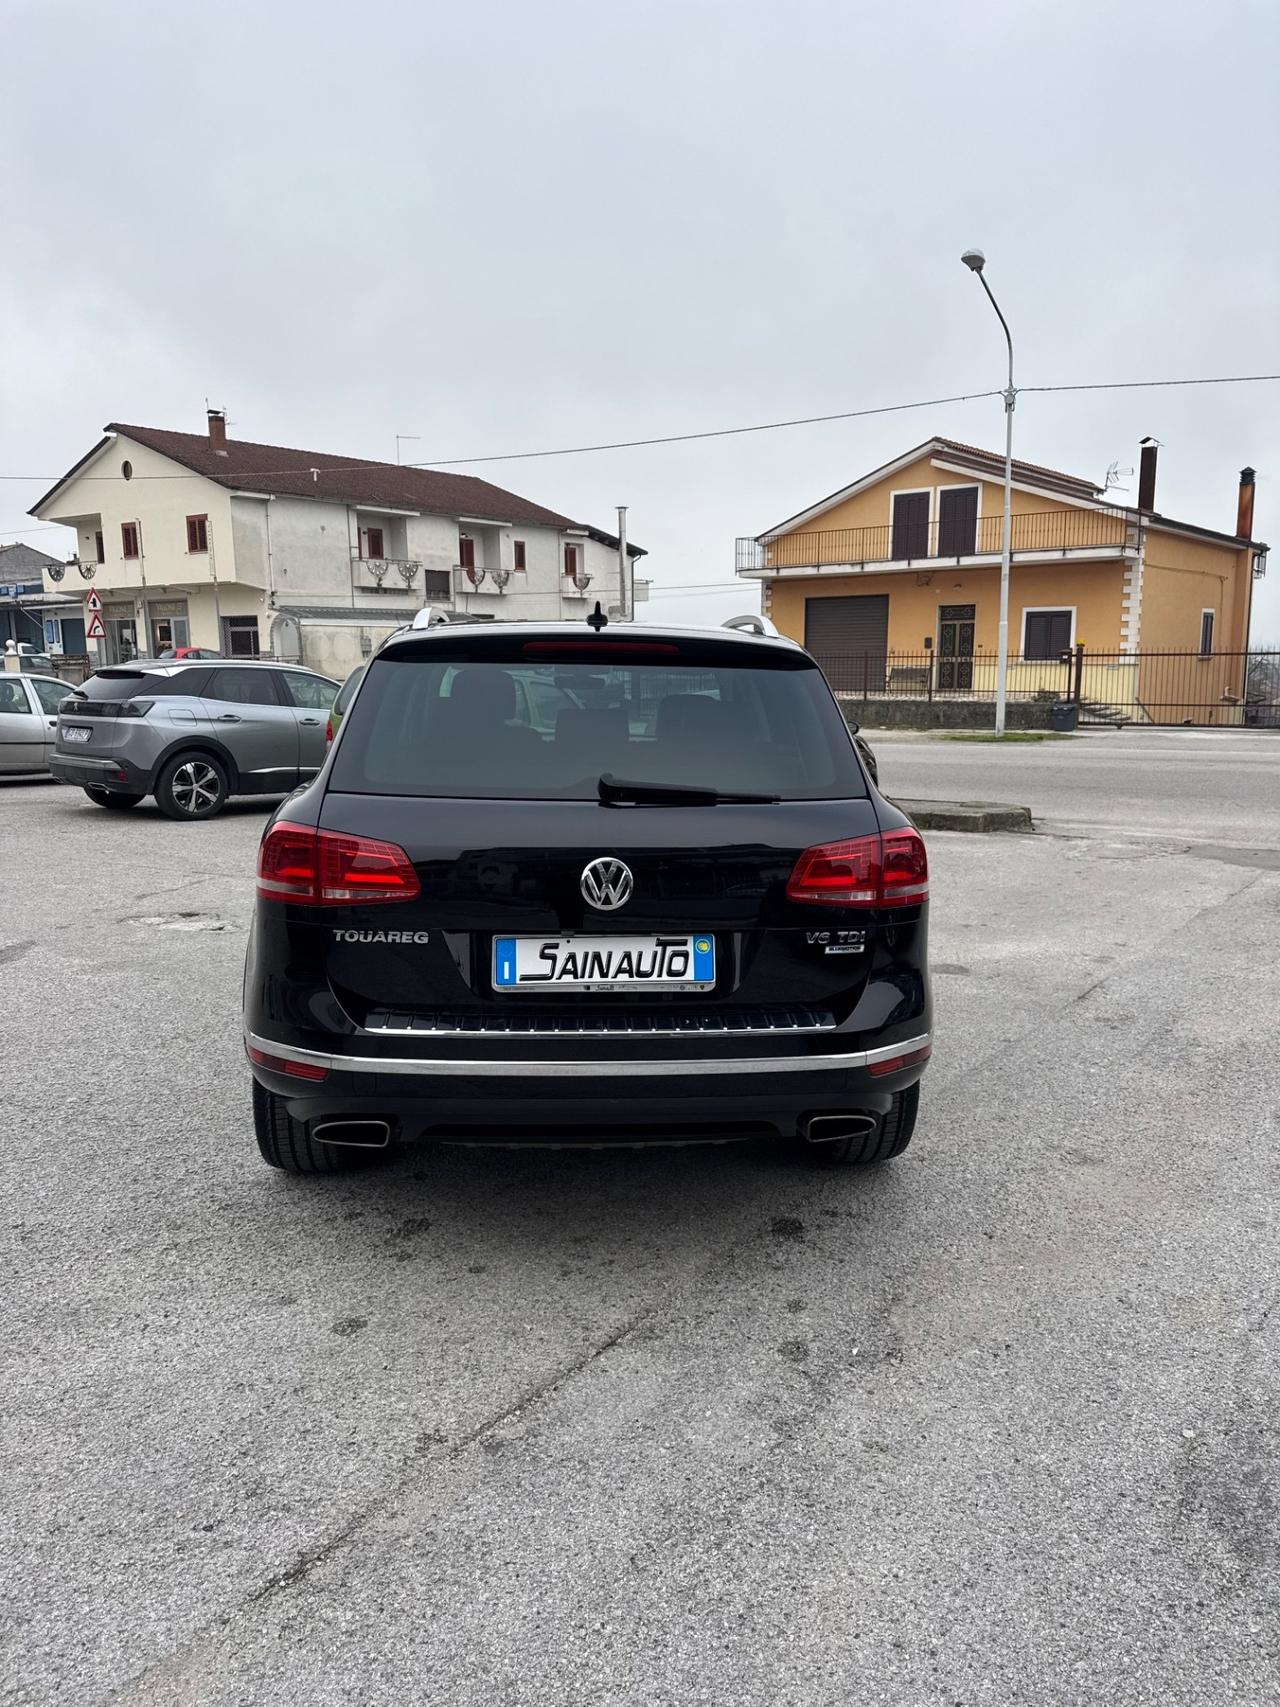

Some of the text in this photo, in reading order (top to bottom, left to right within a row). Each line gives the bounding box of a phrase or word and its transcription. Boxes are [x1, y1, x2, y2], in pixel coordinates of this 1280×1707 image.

[332, 929, 430, 944] TOUAREG
[806, 930, 866, 944] V6 TDI
[519, 938, 690, 981] SAINAUTO
